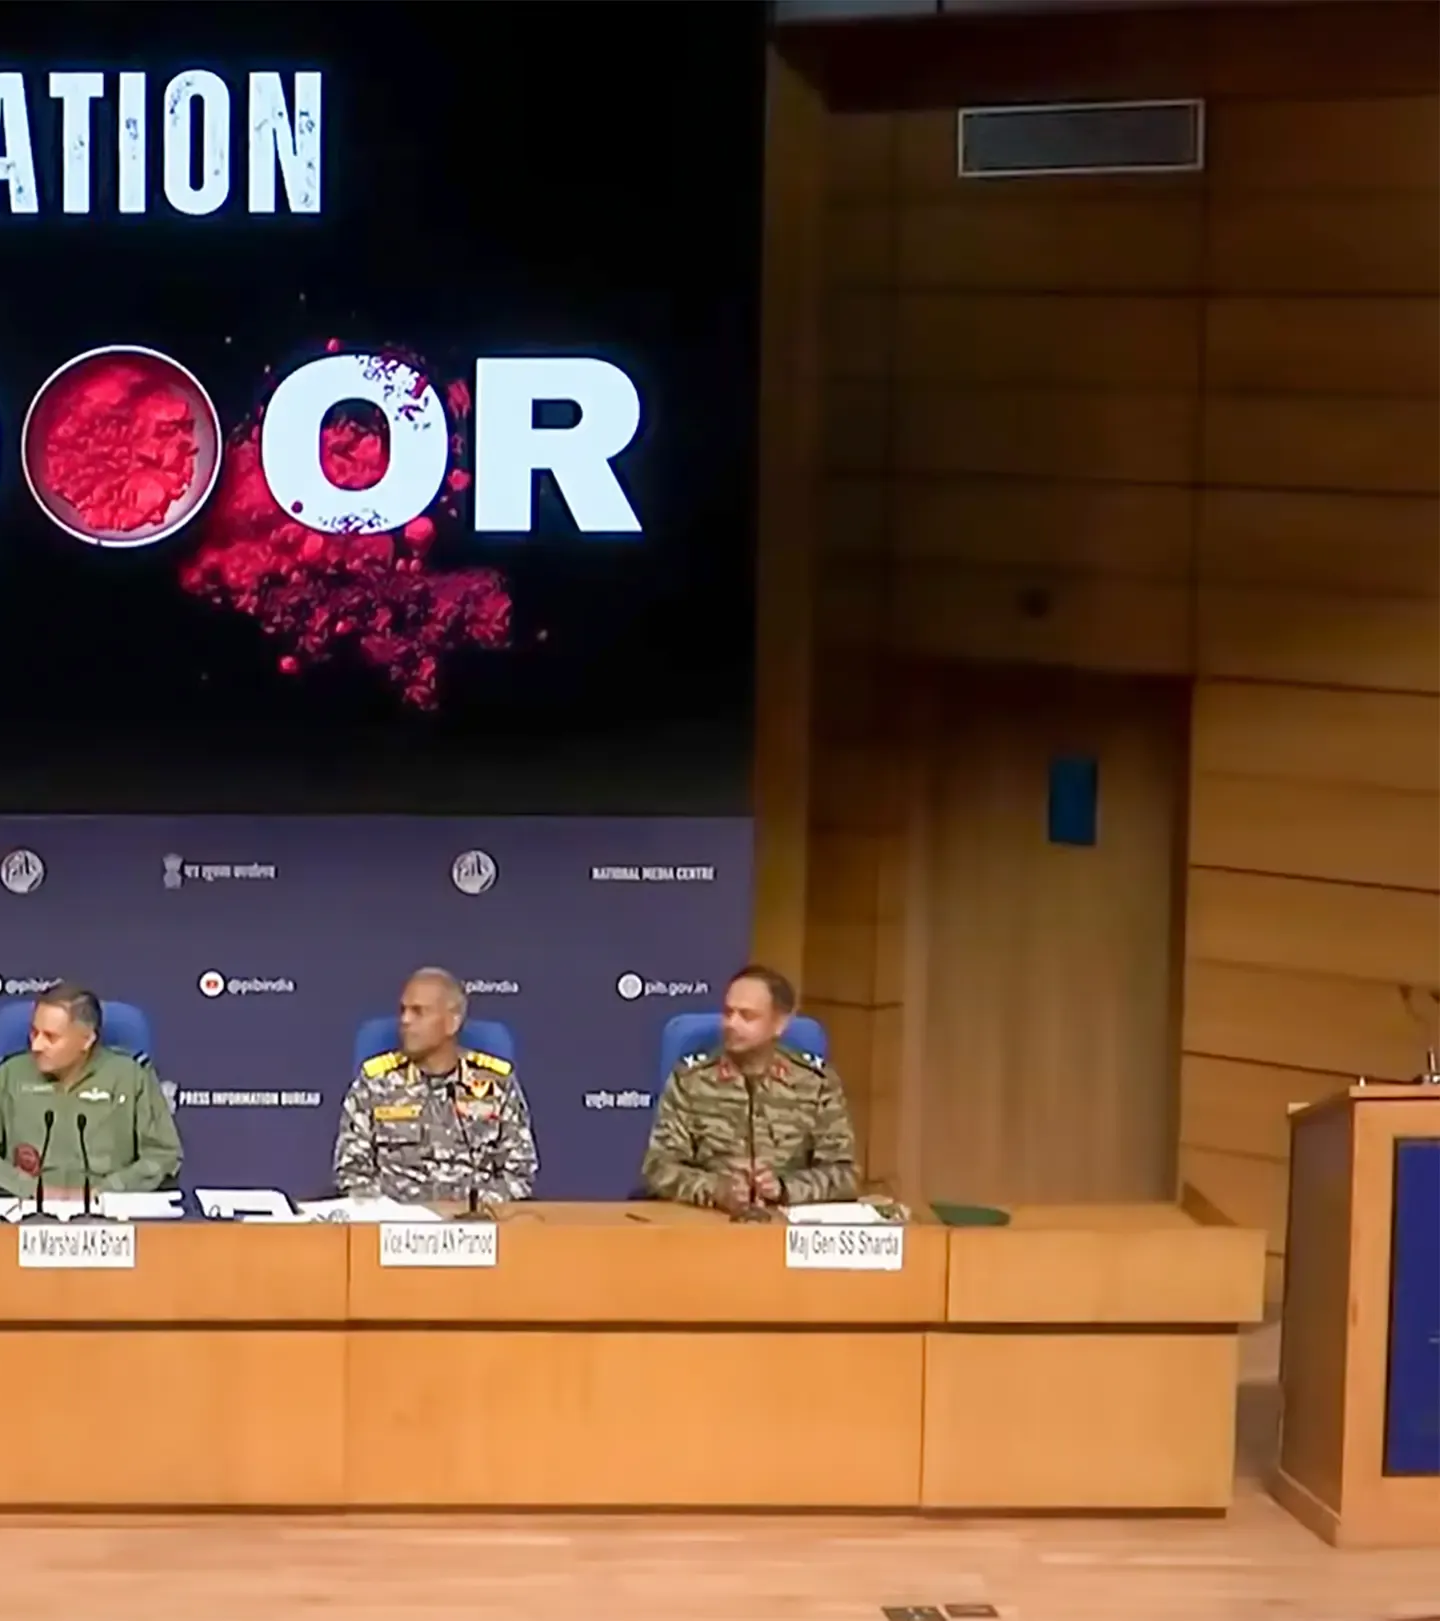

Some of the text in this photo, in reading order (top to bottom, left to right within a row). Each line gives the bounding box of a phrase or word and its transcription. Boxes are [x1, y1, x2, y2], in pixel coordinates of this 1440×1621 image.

[592, 866, 714, 880] NATIONAL MEDIA CENTRE
[227, 978, 295, 995] @pibindia
[461, 979, 519, 995] pibindia
[644, 979, 708, 996] pib.gov.in
[179, 1091, 321, 1106] PRESS INFORMATION BUREAU
[39, 1229, 80, 1256] Marshal
[82, 1229, 99, 1256] AK
[789, 1230, 899, 1260] Maj Gen SS Sharda
